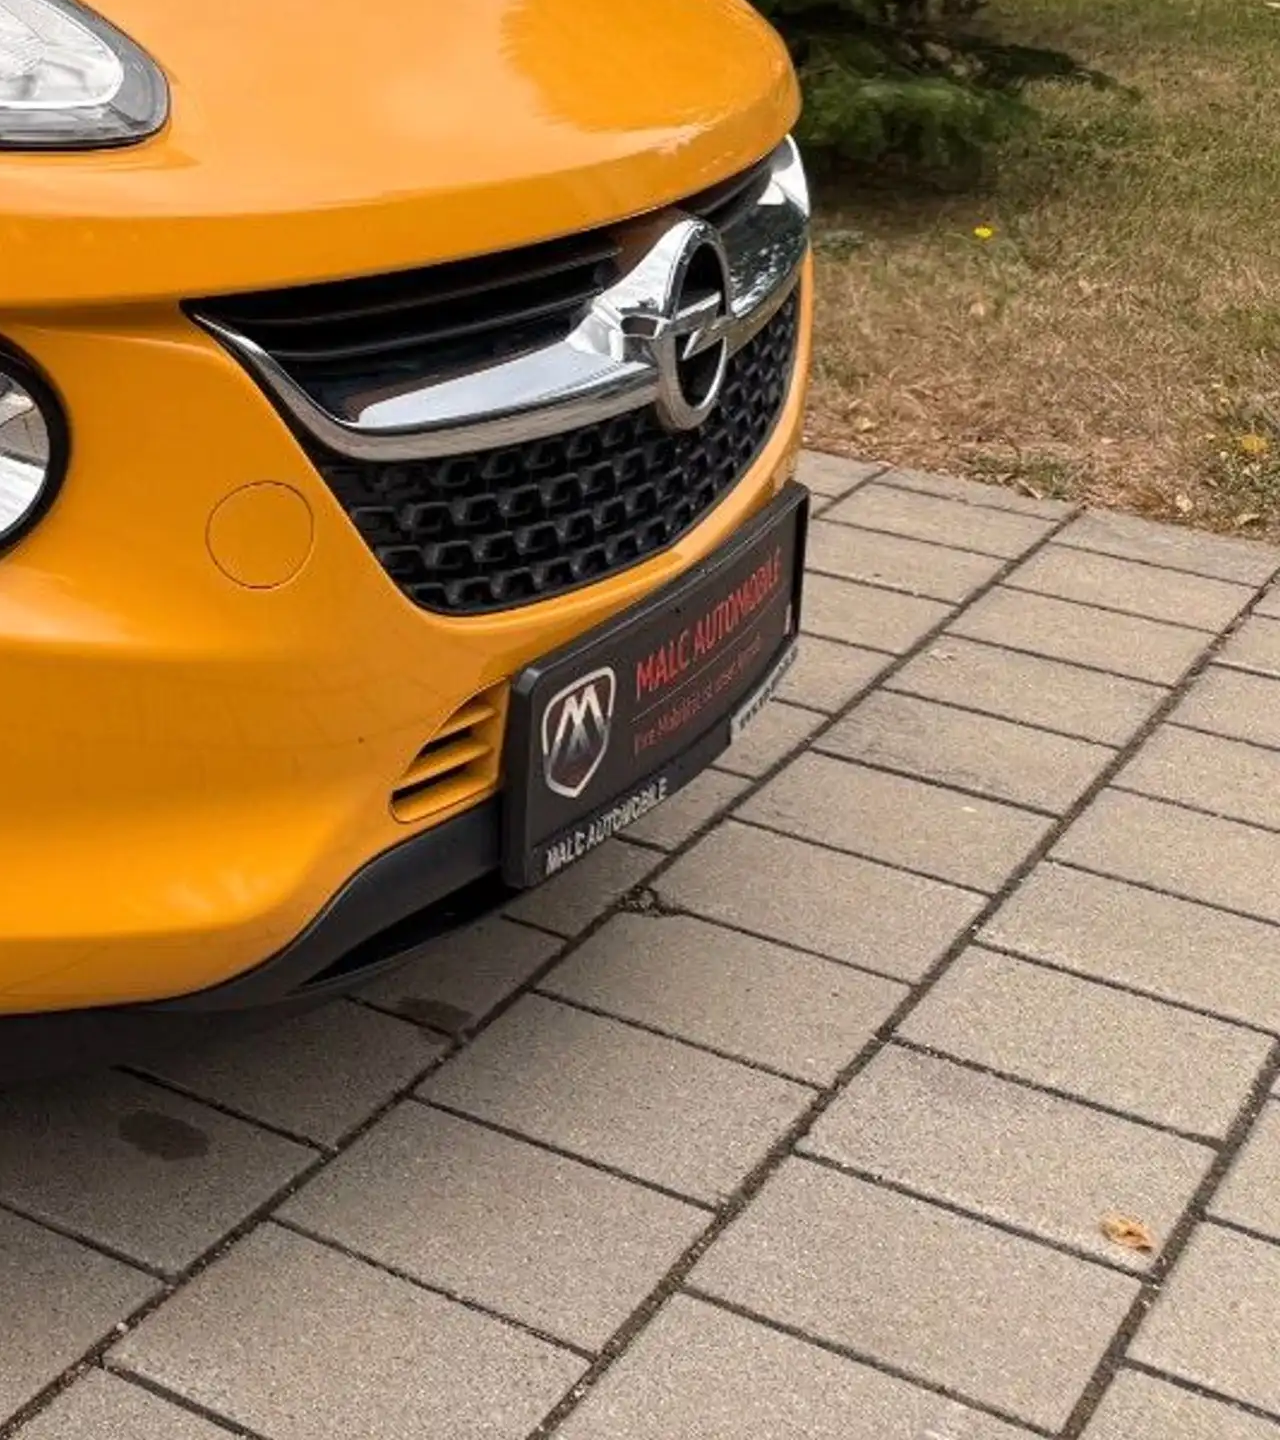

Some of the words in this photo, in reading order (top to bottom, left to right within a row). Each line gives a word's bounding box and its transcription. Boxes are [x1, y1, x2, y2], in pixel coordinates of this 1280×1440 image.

[634, 627, 689, 702] MALC
[693, 544, 782, 657] AUTOMOBILE
[545, 830, 586, 876] MALC
